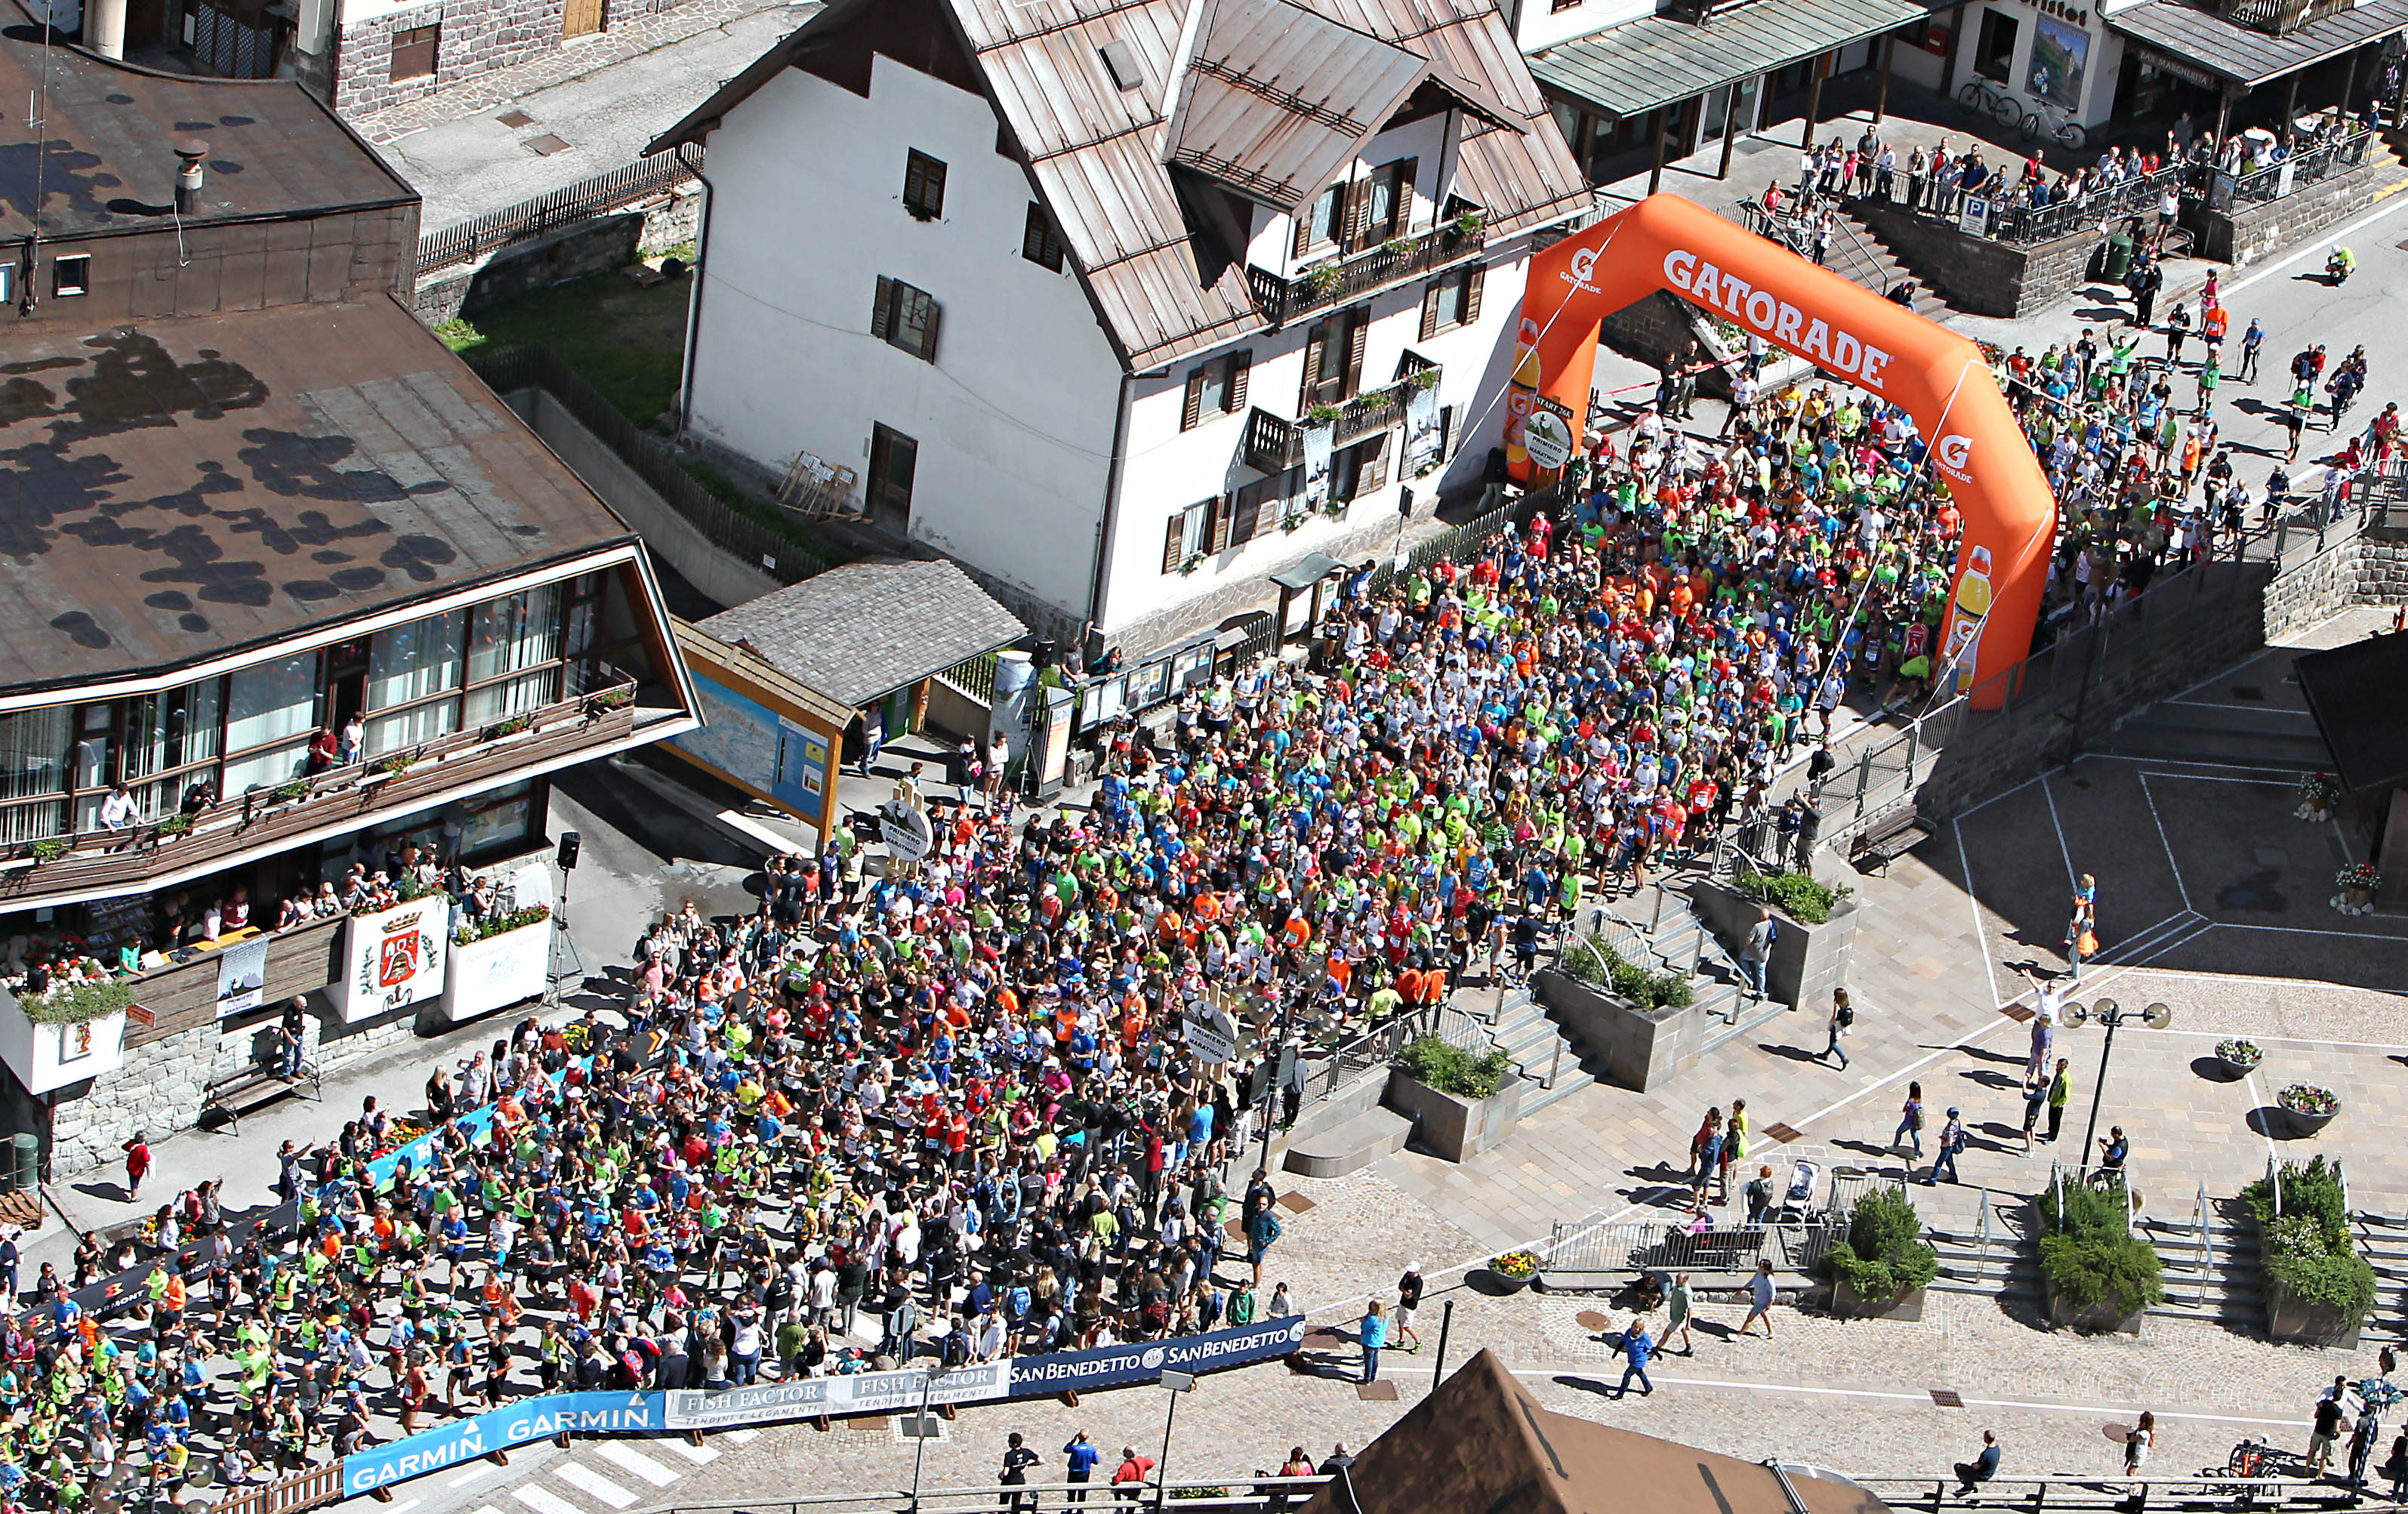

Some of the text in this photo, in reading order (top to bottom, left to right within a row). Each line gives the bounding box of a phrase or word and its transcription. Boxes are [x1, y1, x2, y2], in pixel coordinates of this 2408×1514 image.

[2158, 58, 2207, 85] MARGHERITA
[1969, 201, 1981, 214] P
[1663, 250, 1889, 390] GATORADE
[1536, 396, 1572, 418] START 26K
[1528, 446, 1559, 464] MARATHON
[1532, 436, 1562, 454] PRIMIERO
[889, 825, 920, 846] PRIMIERO
[885, 837, 917, 856] MARATHON
[224, 1002, 252, 1014] MARATHON
[1192, 1027, 1226, 1047] PRIMIERO
[1189, 1038, 1223, 1059] MARATHON
[861, 1369, 988, 1394] FISH FACTOR
[687, 1386, 818, 1411] FISH FACTOR
[859, 1395, 905, 1408] TENDINI
[928, 1389, 988, 1401] EGAMENTI
[507, 1408, 649, 1441] GARMIN
[686, 1414, 734, 1426] TENDINI
[751, 1405, 817, 1419] LEGAMENTI
[353, 1433, 483, 1490] GARMIN
